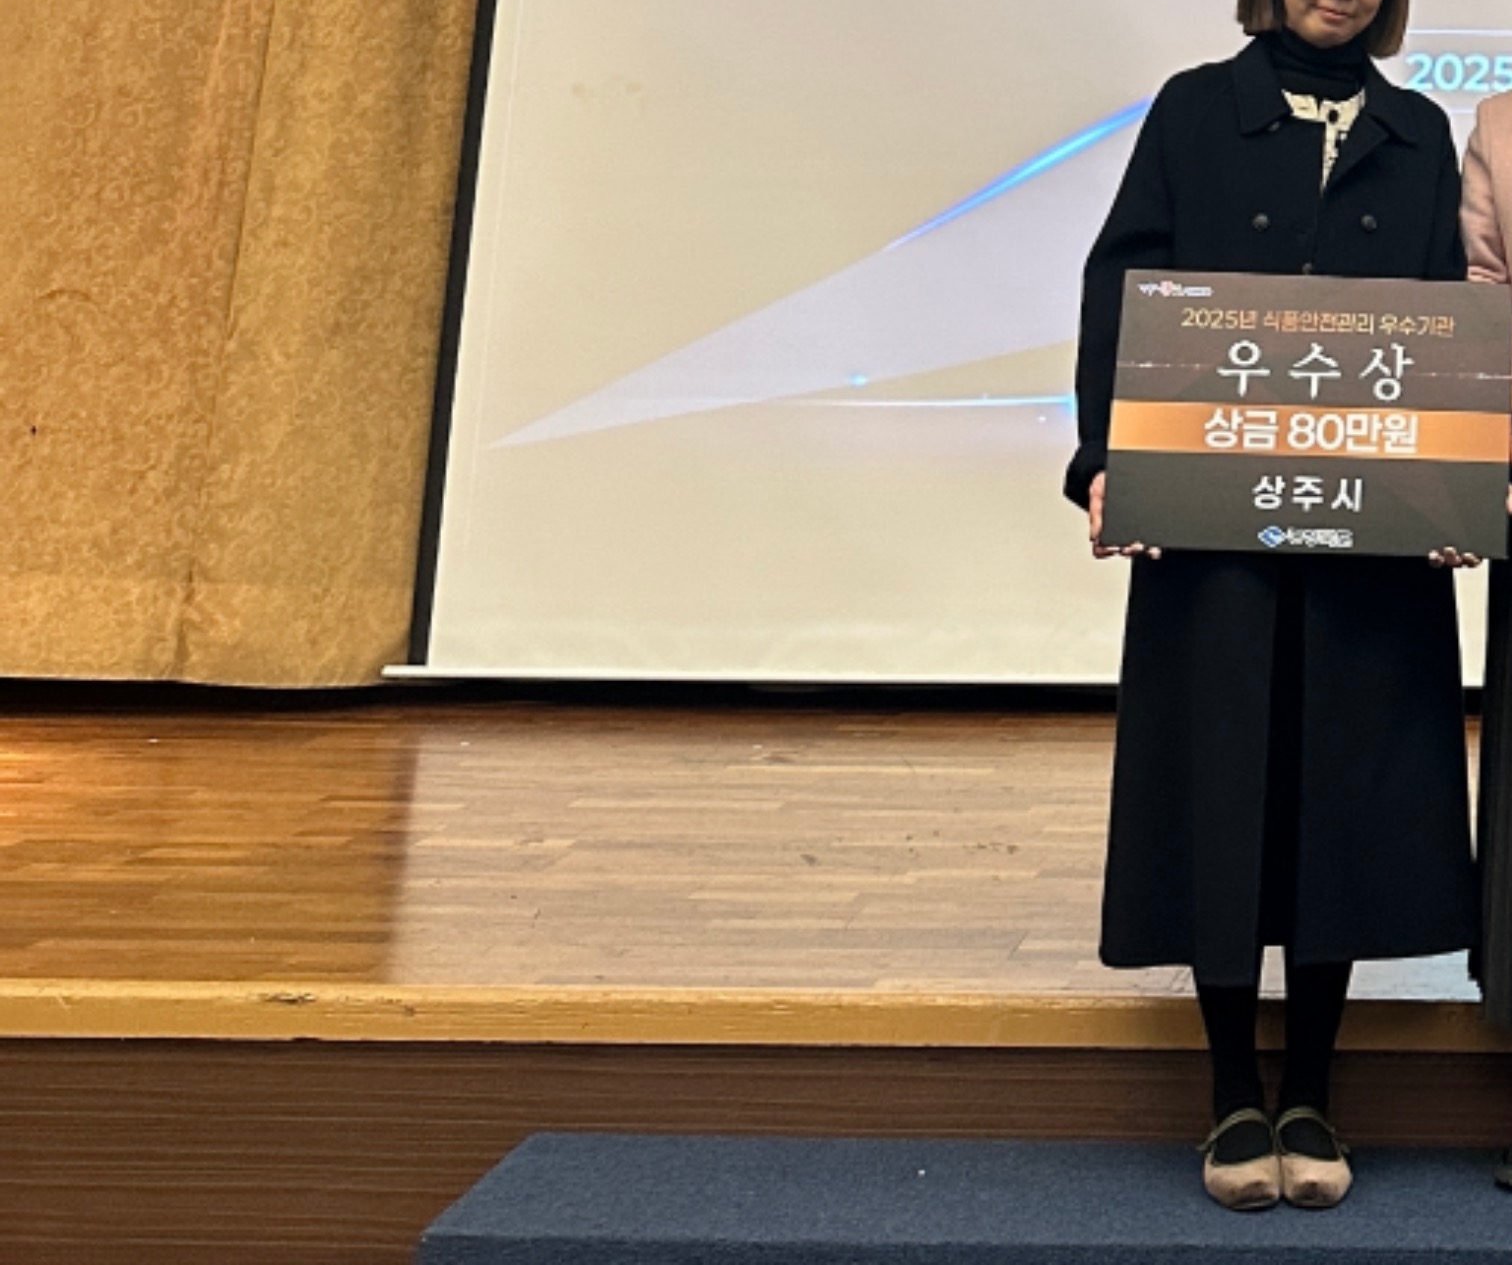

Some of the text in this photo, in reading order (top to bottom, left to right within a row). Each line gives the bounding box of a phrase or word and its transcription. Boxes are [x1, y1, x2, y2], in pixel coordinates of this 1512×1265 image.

[1181, 306, 1455, 337] 2025년 식품안전관리 우수기관
[1204, 407, 1419, 454] 상금 80만원
[1252, 474, 1364, 513] 상주시
